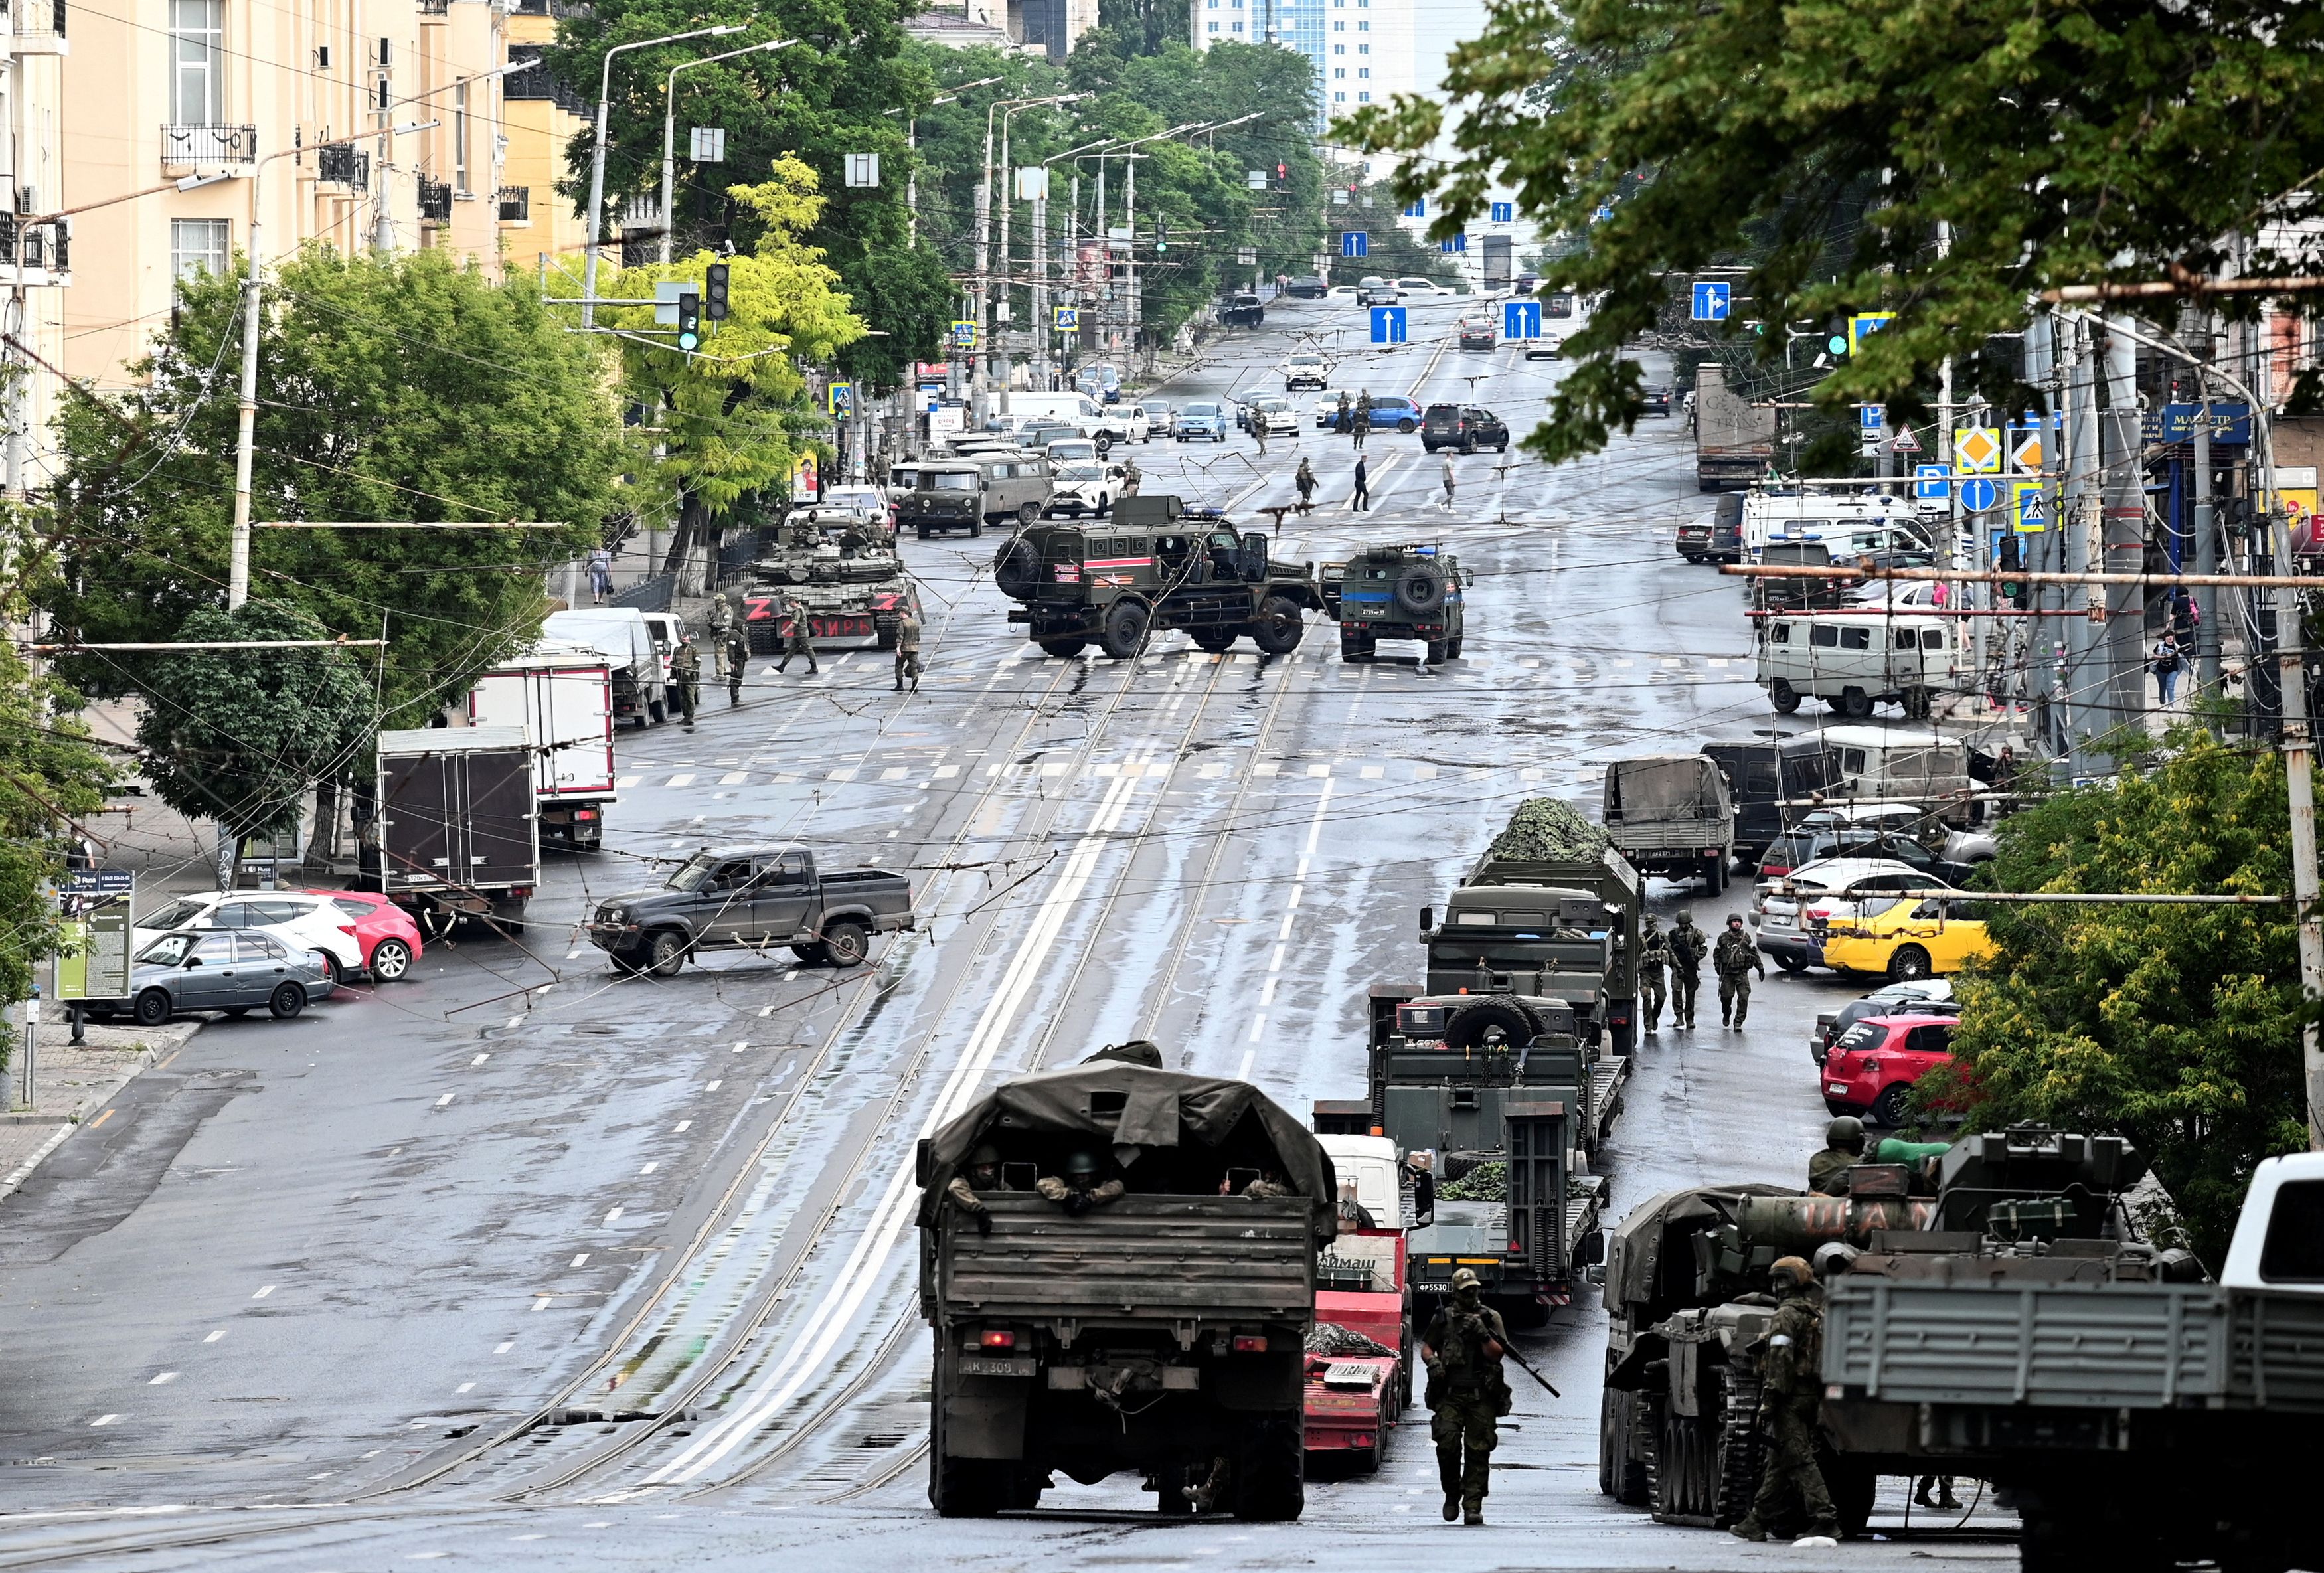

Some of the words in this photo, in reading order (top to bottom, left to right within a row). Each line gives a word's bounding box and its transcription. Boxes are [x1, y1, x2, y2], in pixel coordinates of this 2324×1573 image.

[687, 317, 697, 329] 2
[1924, 469, 1942, 494] P
[744, 598, 771, 620] Z
[870, 594, 900, 610] Z
[781, 618, 870, 637] СБИРЬ
[1318, 1255, 1376, 1269] оймаш
